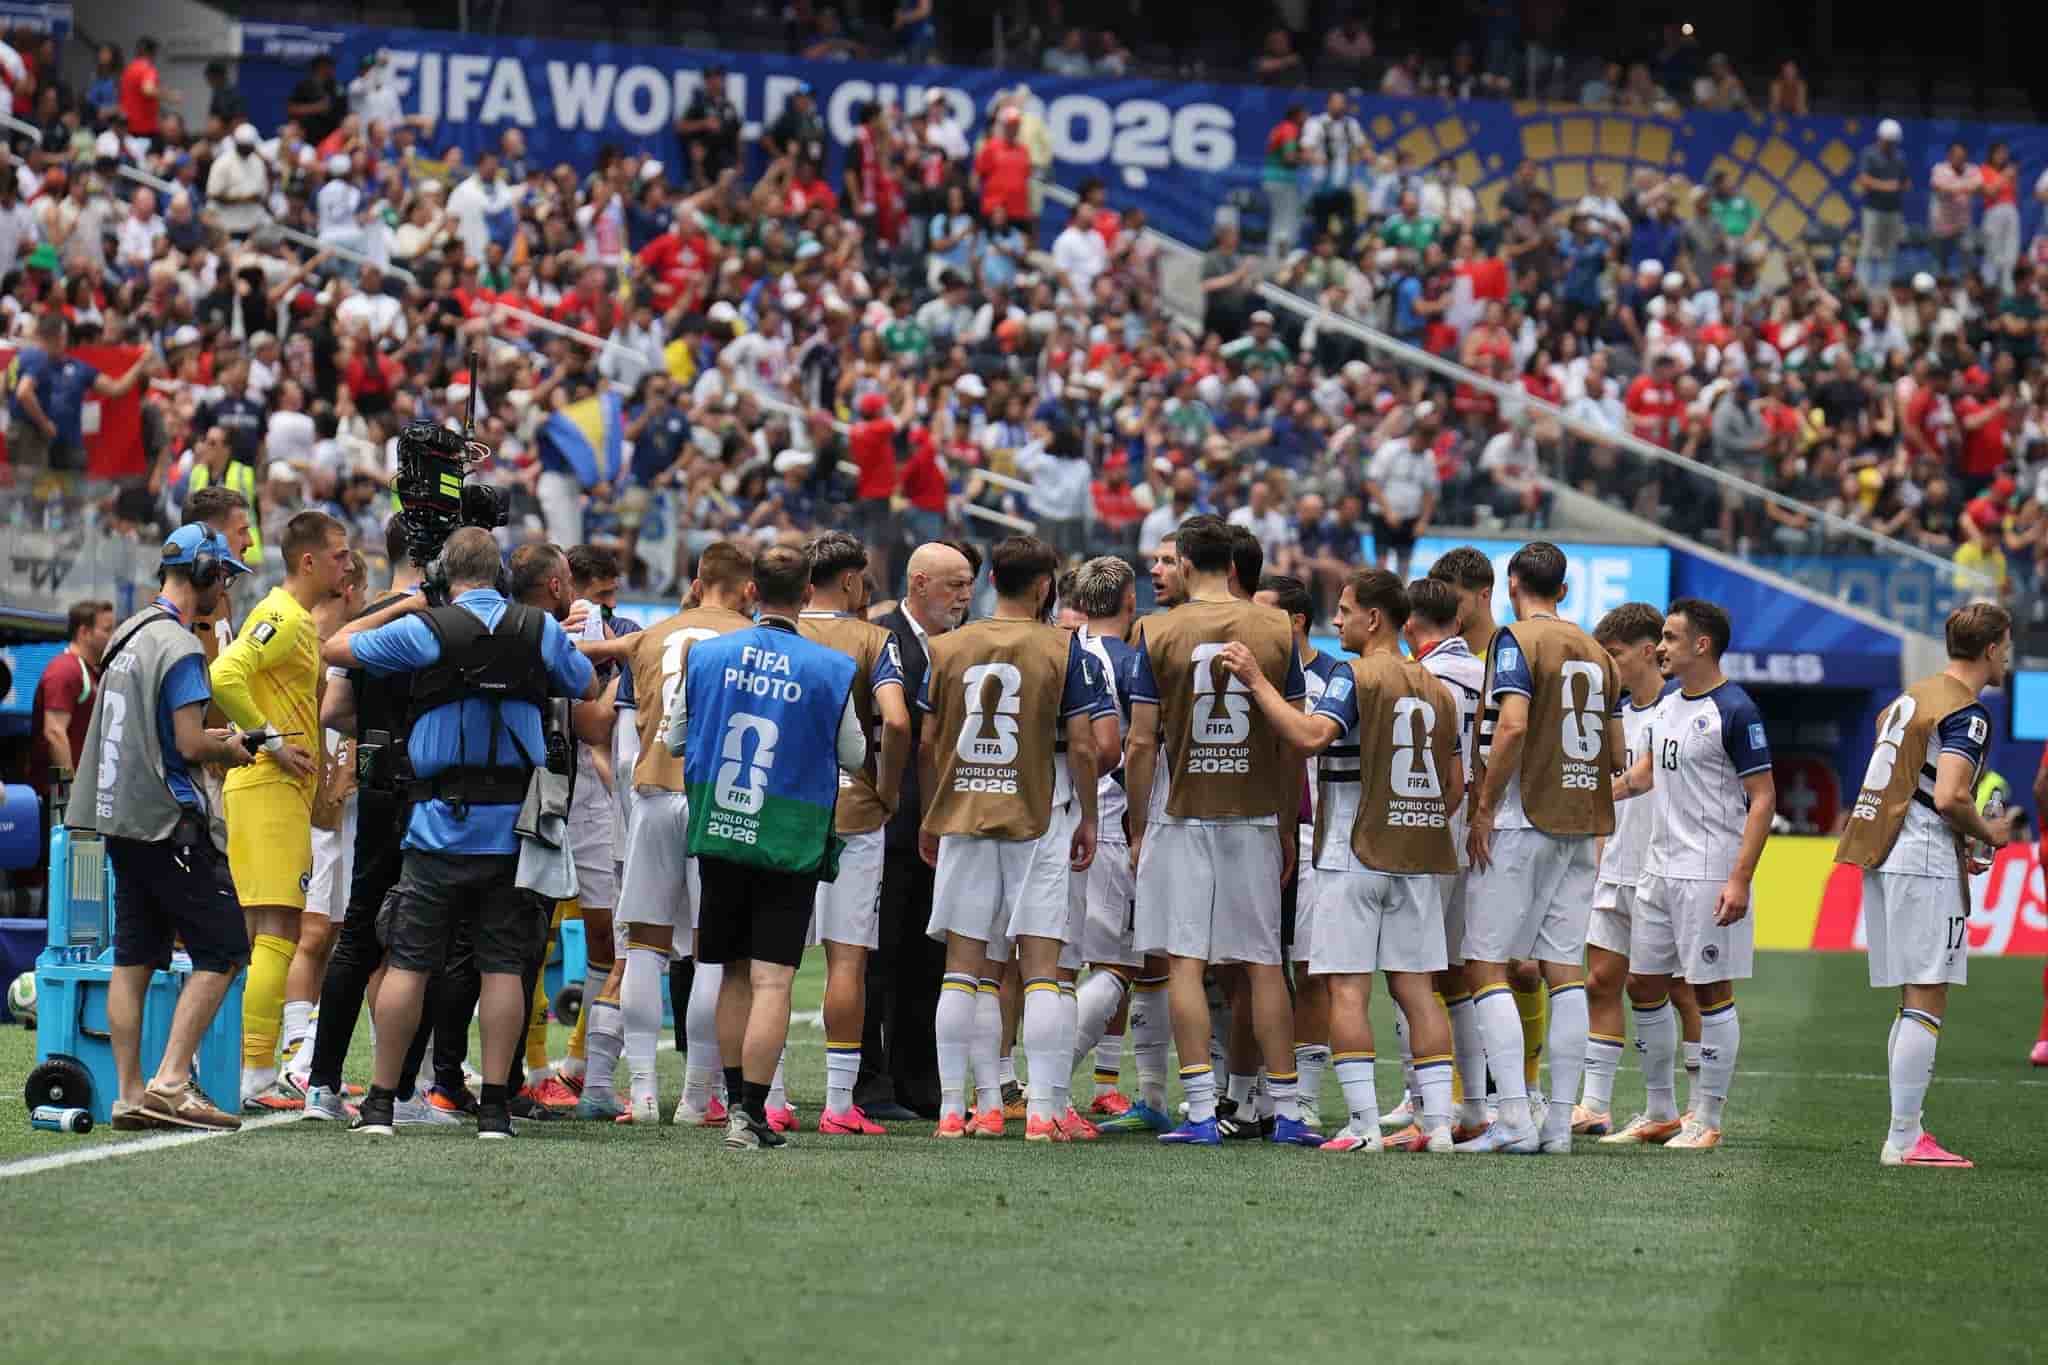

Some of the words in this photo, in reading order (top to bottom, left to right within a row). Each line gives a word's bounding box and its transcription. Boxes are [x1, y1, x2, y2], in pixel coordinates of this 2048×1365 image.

[988, 90, 1236, 171] 026
[742, 646, 790, 675] FIFA
[724, 667, 802, 702] PHOTO
[1206, 723, 1234, 735] FIFA
[974, 743, 1002, 755] FIFA
[1190, 747, 1227, 758] WORLD
[1229, 747, 1249, 757] CUP
[1662, 738, 1678, 770] 13
[955, 767, 995, 777] WORLD
[996, 767, 1018, 777] CUP
[1188, 758, 1249, 773] 2026
[954, 777, 1018, 794] 2026
[1407, 777, 1430, 789] FIFA
[727, 790, 752, 806] FIFA
[1389, 800, 1422, 810] WORLD
[1424, 801, 1446, 812] CUP
[710, 809, 743, 825] WORLD
[743, 818, 760, 829] CUP
[1387, 811, 1446, 828] 2026
[707, 821, 757, 845] 2026
[1947, 916, 1965, 949] 17
